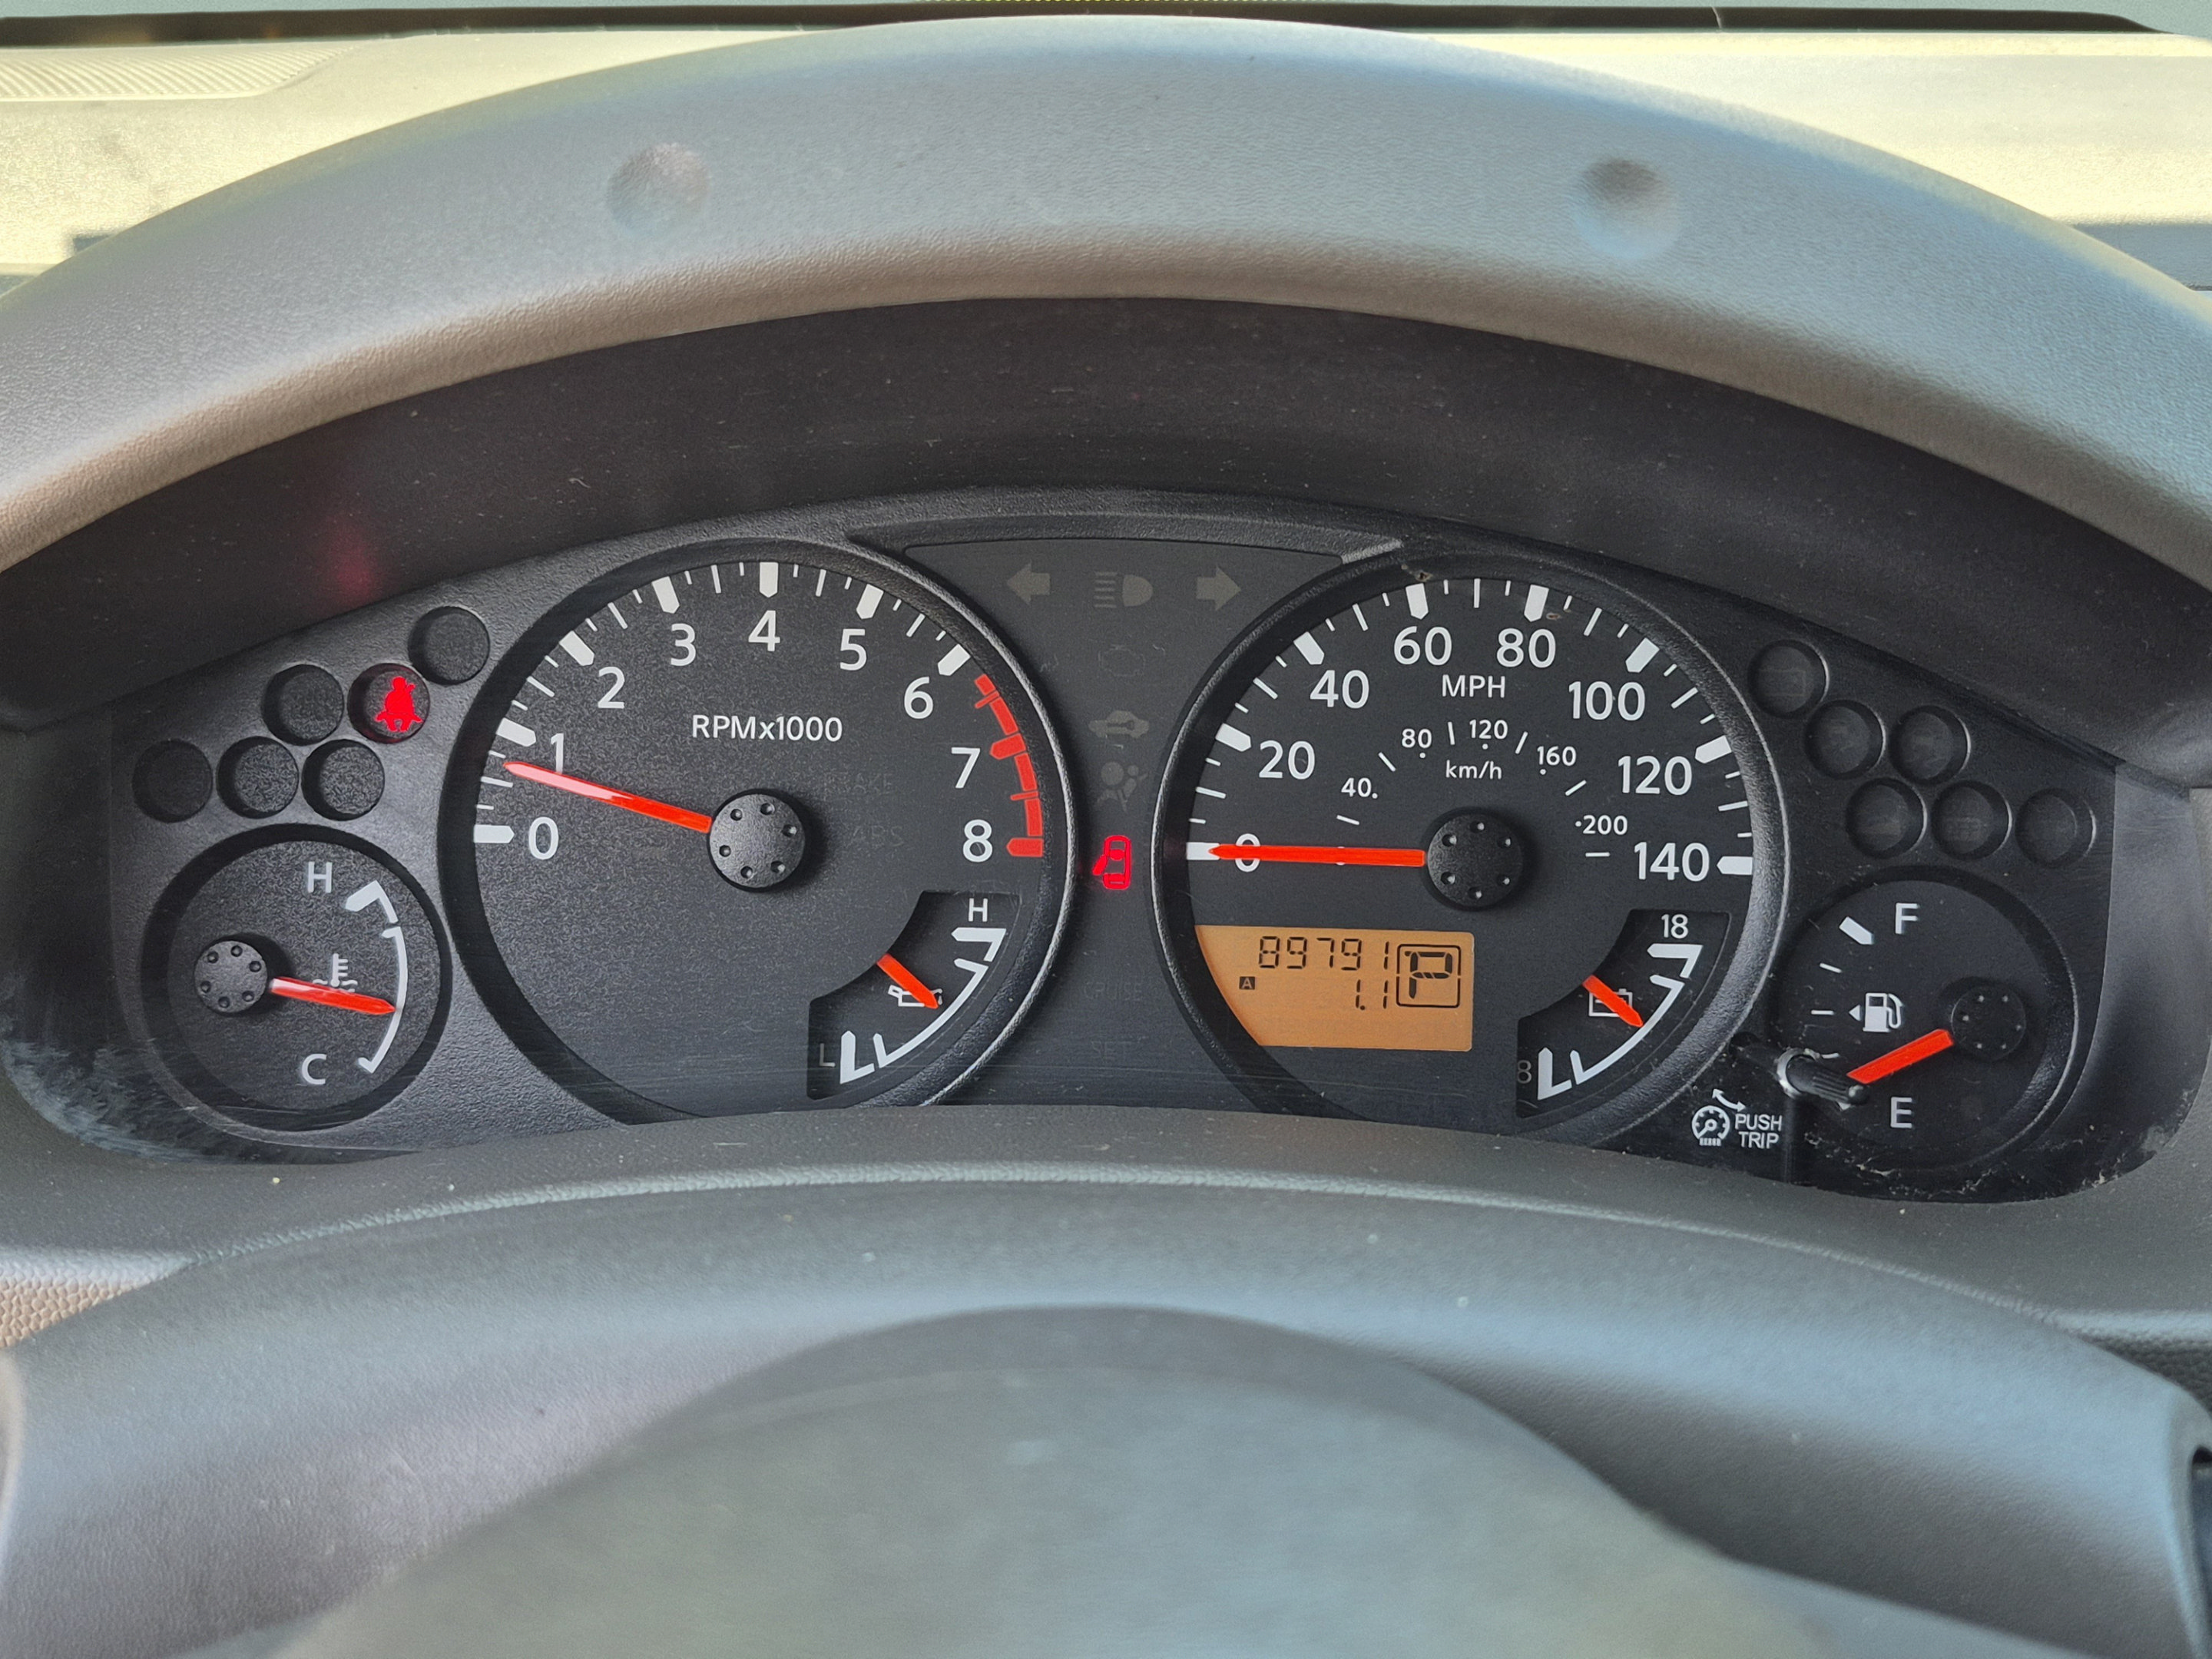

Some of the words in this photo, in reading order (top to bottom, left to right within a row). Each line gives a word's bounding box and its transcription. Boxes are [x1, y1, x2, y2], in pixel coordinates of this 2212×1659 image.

[670, 623, 697, 667] 3
[748, 611, 780, 653] 4
[839, 628, 867, 671] 5
[1393, 625, 1452, 666] 60
[1496, 628, 1556, 668] 80
[597, 666, 625, 710] 2
[904, 676, 934, 720] 6
[1309, 669, 1370, 709] 40
[1442, 674, 1505, 698] MPH
[1568, 680, 1646, 721] 100
[692, 714, 843, 742] RPMx1000
[1402, 728, 1432, 749] 80
[1469, 718, 1508, 740] 120
[549, 732, 565, 775] 1
[951, 747, 981, 789] 7
[1259, 740, 1316, 780] 20
[1445, 760, 1502, 780] km/h
[1537, 746, 1577, 767] 160
[1341, 777, 1373, 796] 40
[1618, 755, 1693, 796] 120
[528, 816, 559, 860] 0
[962, 819, 993, 863] 8
[1582, 813, 1628, 836] 200
[1235, 833, 1260, 873] 0
[1634, 842, 1710, 882] 140
[306, 861, 333, 893] H
[968, 898, 988, 922] H
[1661, 914, 1689, 939] 18
[1895, 902, 1919, 935] F
[1404, 951, 1454, 999] P
[300, 1053, 327, 1085] C
[819, 1042, 836, 1068] L
[1516, 1059, 1532, 1084] 8
[1734, 1113, 1783, 1131] PUSH
[1890, 1096, 1912, 1129] E
[1738, 1131, 1780, 1149] TRIP
